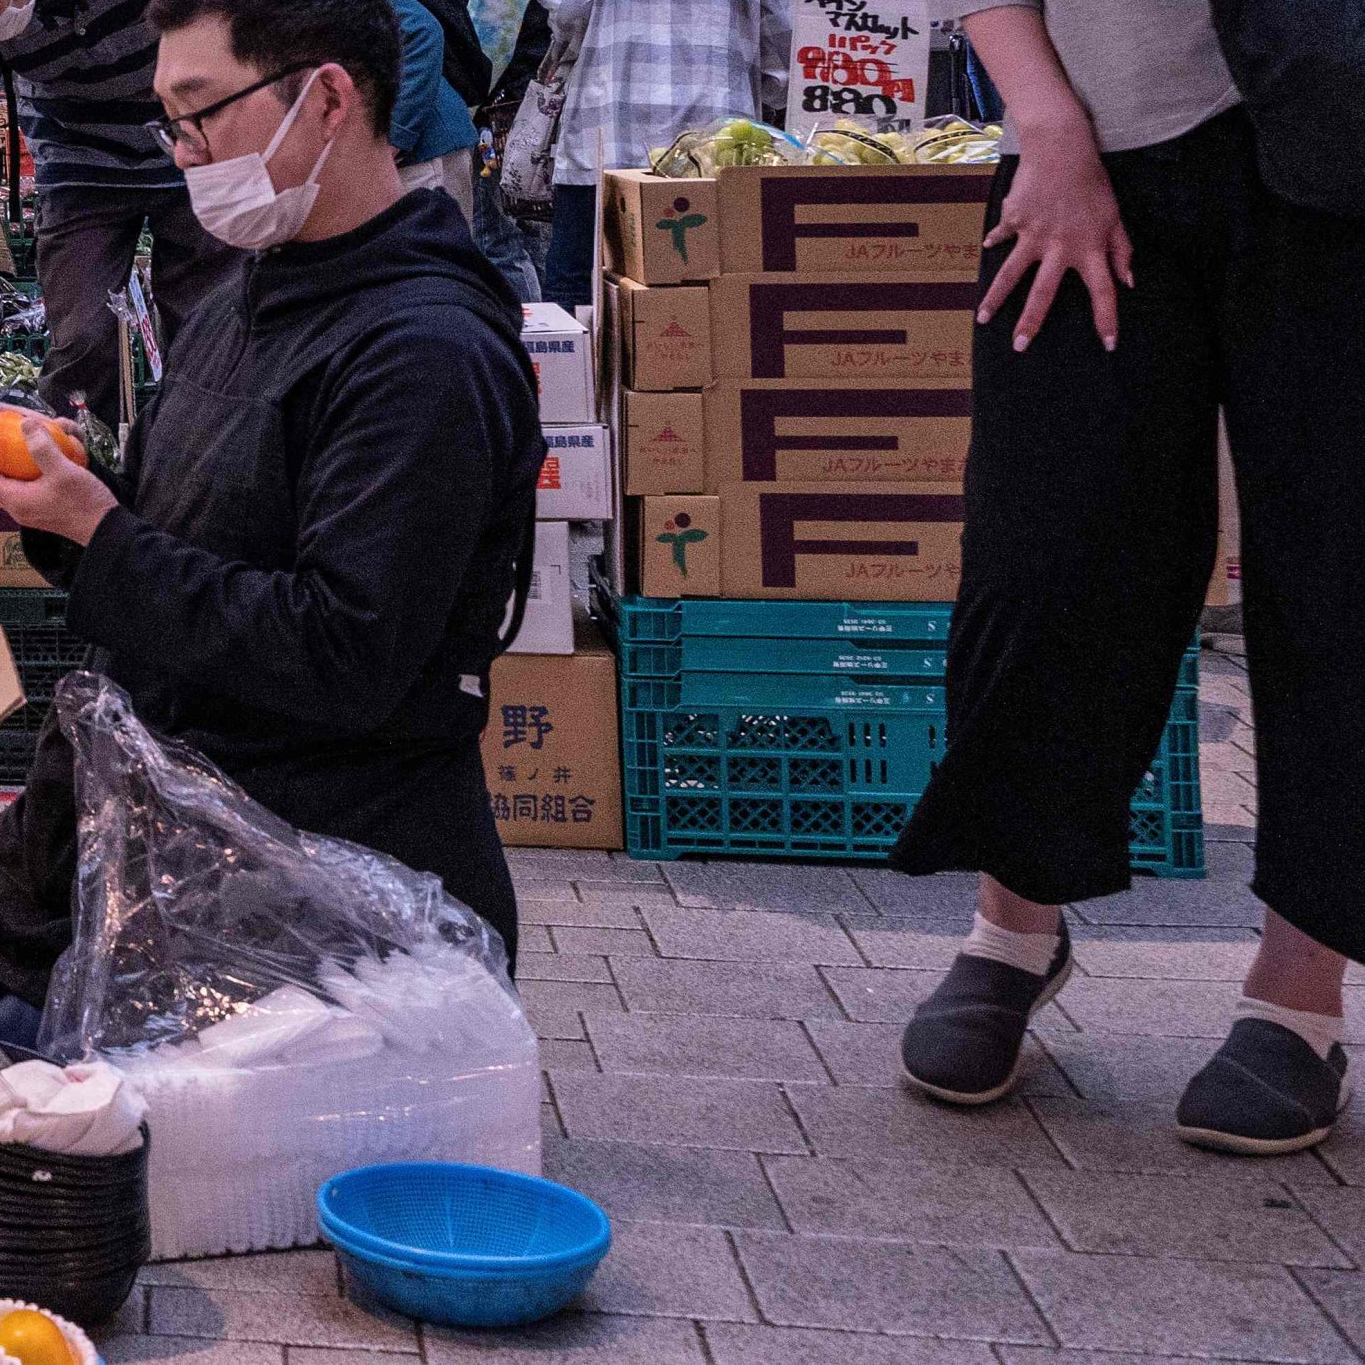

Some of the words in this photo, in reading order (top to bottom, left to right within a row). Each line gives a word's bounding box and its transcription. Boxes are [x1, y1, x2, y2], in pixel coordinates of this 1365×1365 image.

[825, 11, 919, 40] マスカット
[802, 85, 898, 117] 880
[501, 704, 553, 749] 野
[497, 766, 573, 784] 篠ノ井
